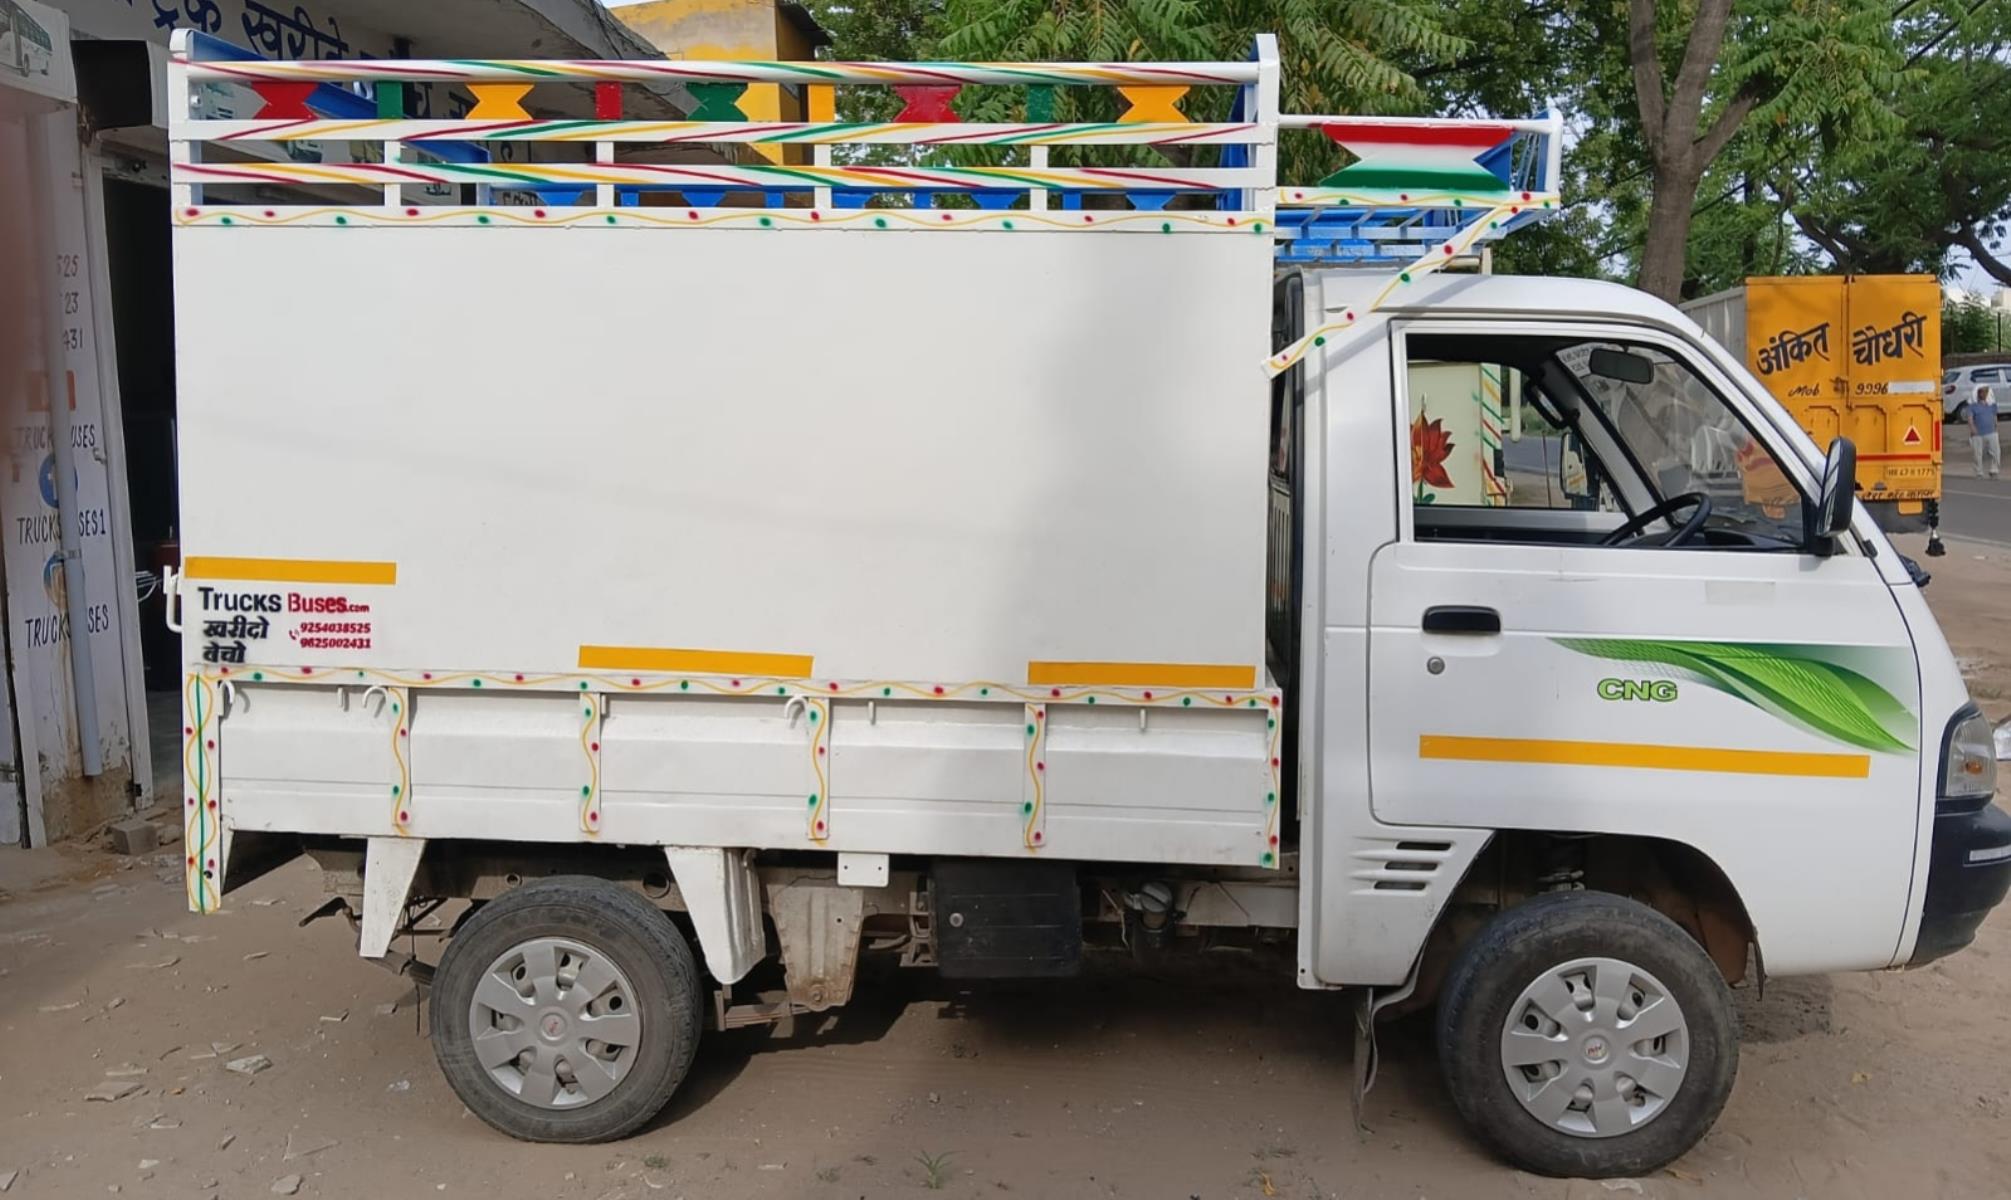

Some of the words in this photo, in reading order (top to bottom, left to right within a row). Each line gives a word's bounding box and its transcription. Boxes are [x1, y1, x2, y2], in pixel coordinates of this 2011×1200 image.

[1757, 322, 1831, 376] अंकित
[203, 615, 270, 640] खरीदो
[1597, 678, 1678, 702] CNG
